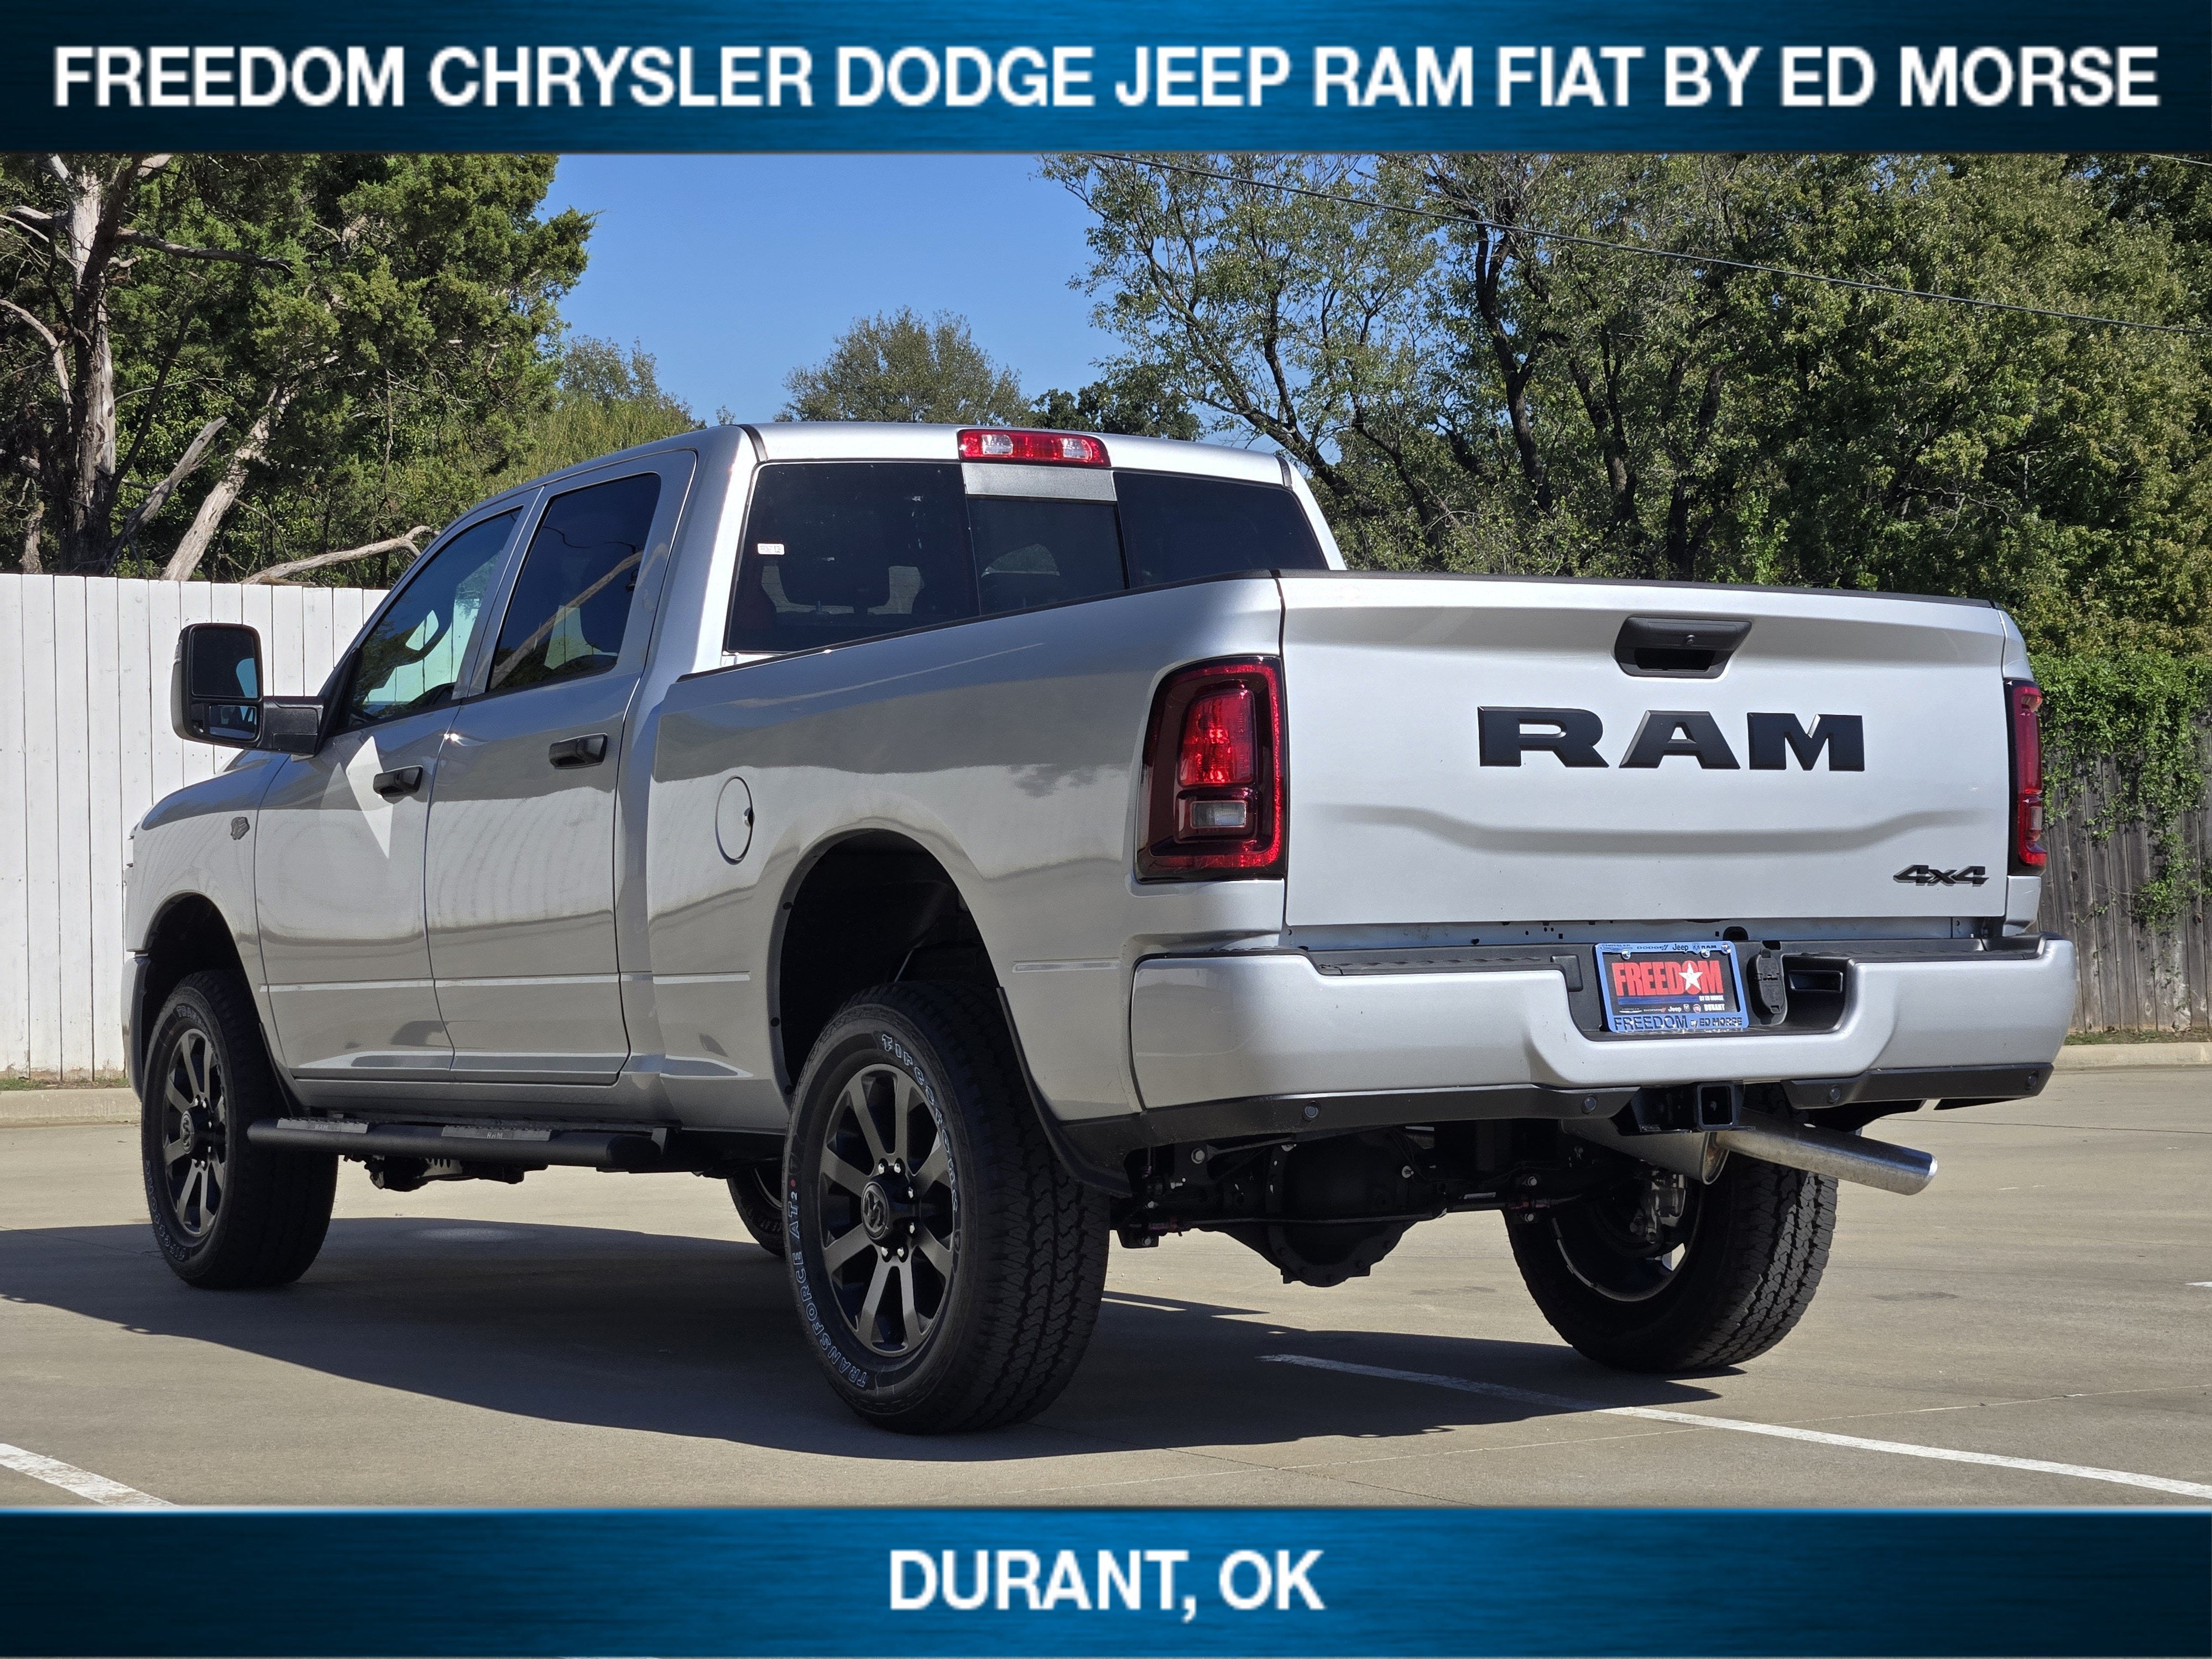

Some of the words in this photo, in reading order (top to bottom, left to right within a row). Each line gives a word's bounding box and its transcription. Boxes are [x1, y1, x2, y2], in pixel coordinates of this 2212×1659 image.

[1477, 706, 1864, 772] RAM
[1893, 864, 1989, 887] 4x4
[1672, 943, 1689, 952] Jeep
[1611, 960, 1724, 996] FREEDOM
[1614, 1015, 1688, 1031] FREEDOM
[1699, 1018, 1710, 1026] ED
[792, 1252, 871, 1388] TRANSFORCE
